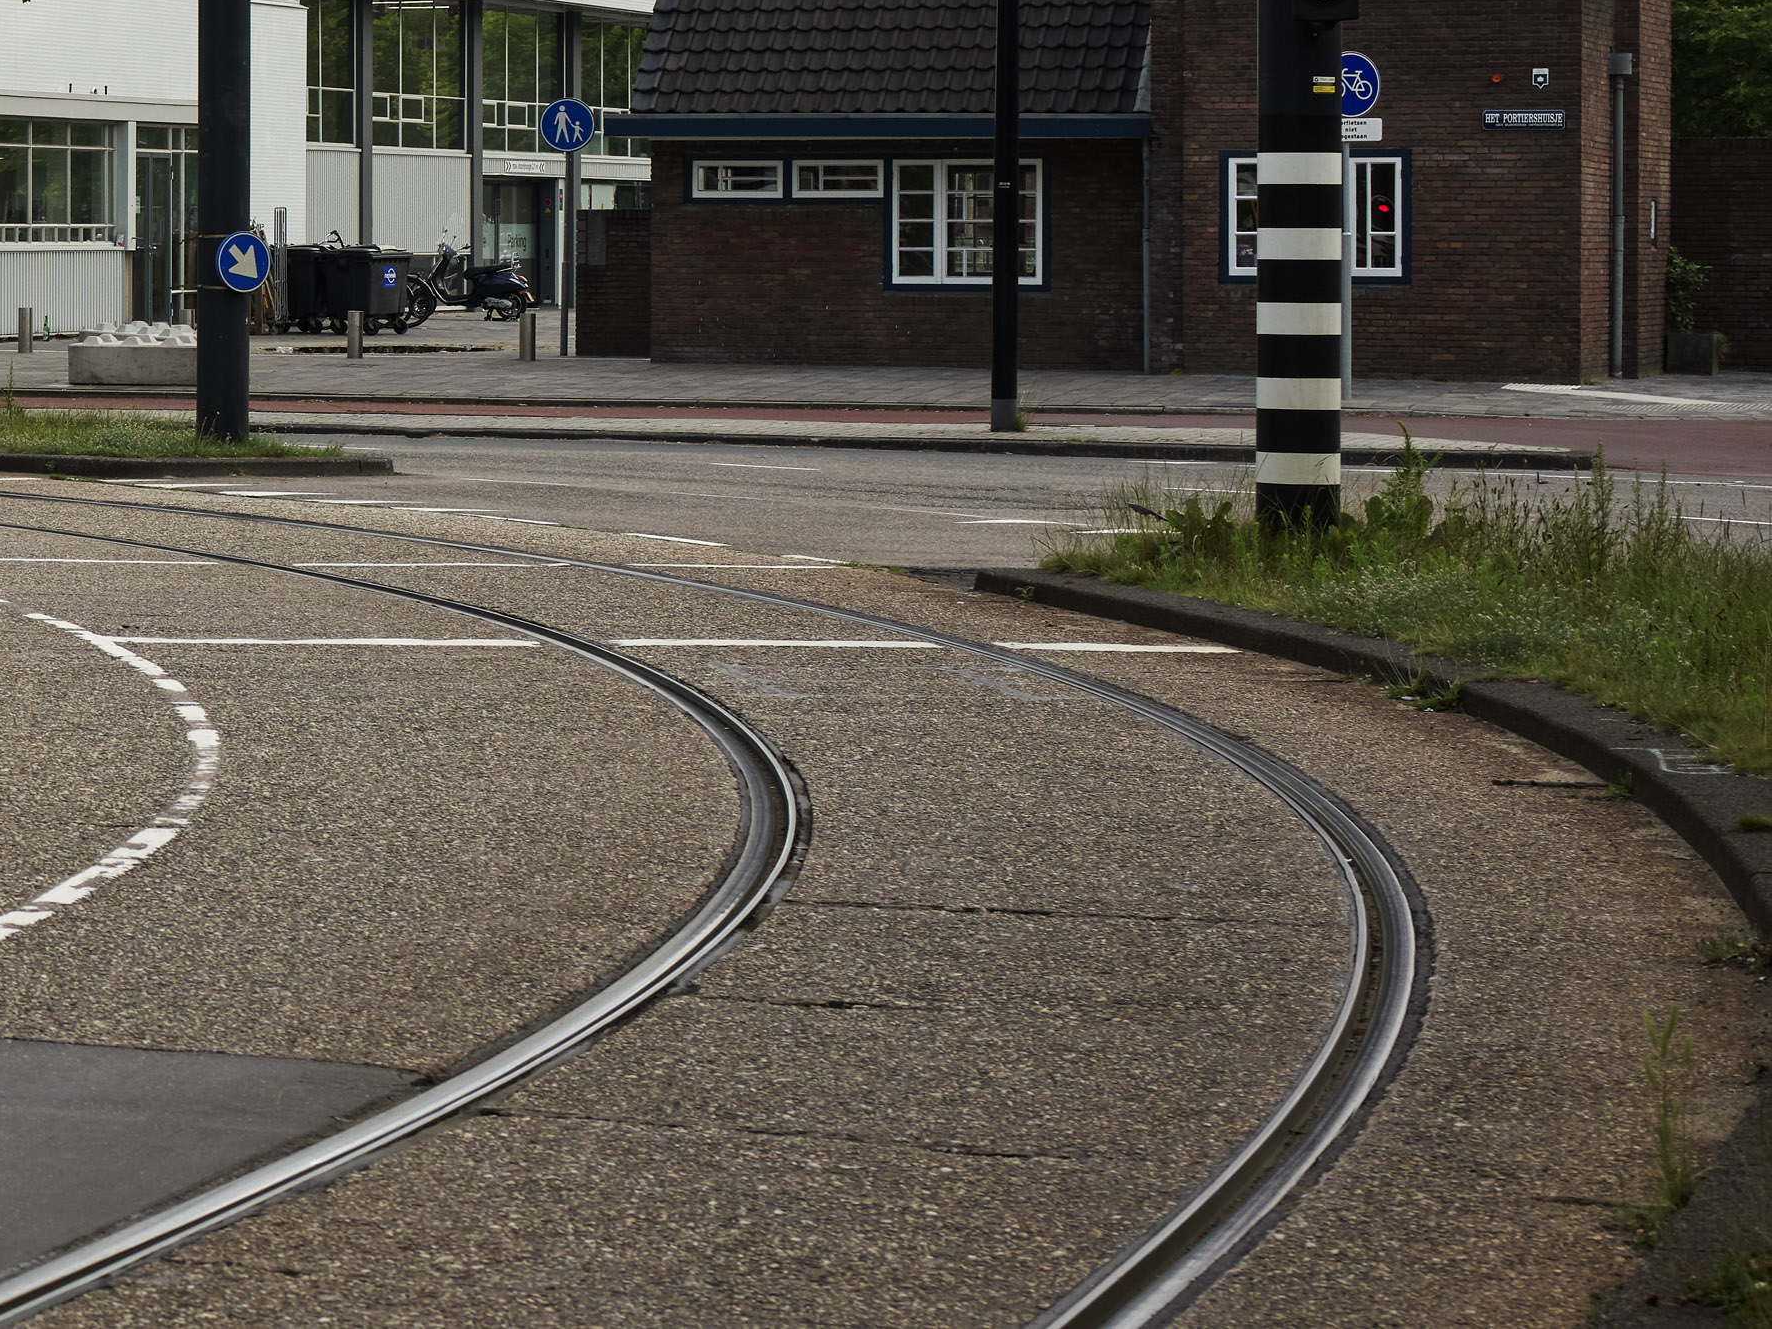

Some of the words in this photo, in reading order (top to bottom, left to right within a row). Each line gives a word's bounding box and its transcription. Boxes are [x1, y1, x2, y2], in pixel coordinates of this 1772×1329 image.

[1485, 113, 1500, 123] HET
[1503, 113, 1563, 123] PORTIERSHUISJE
[508, 234, 526, 251] Parking
